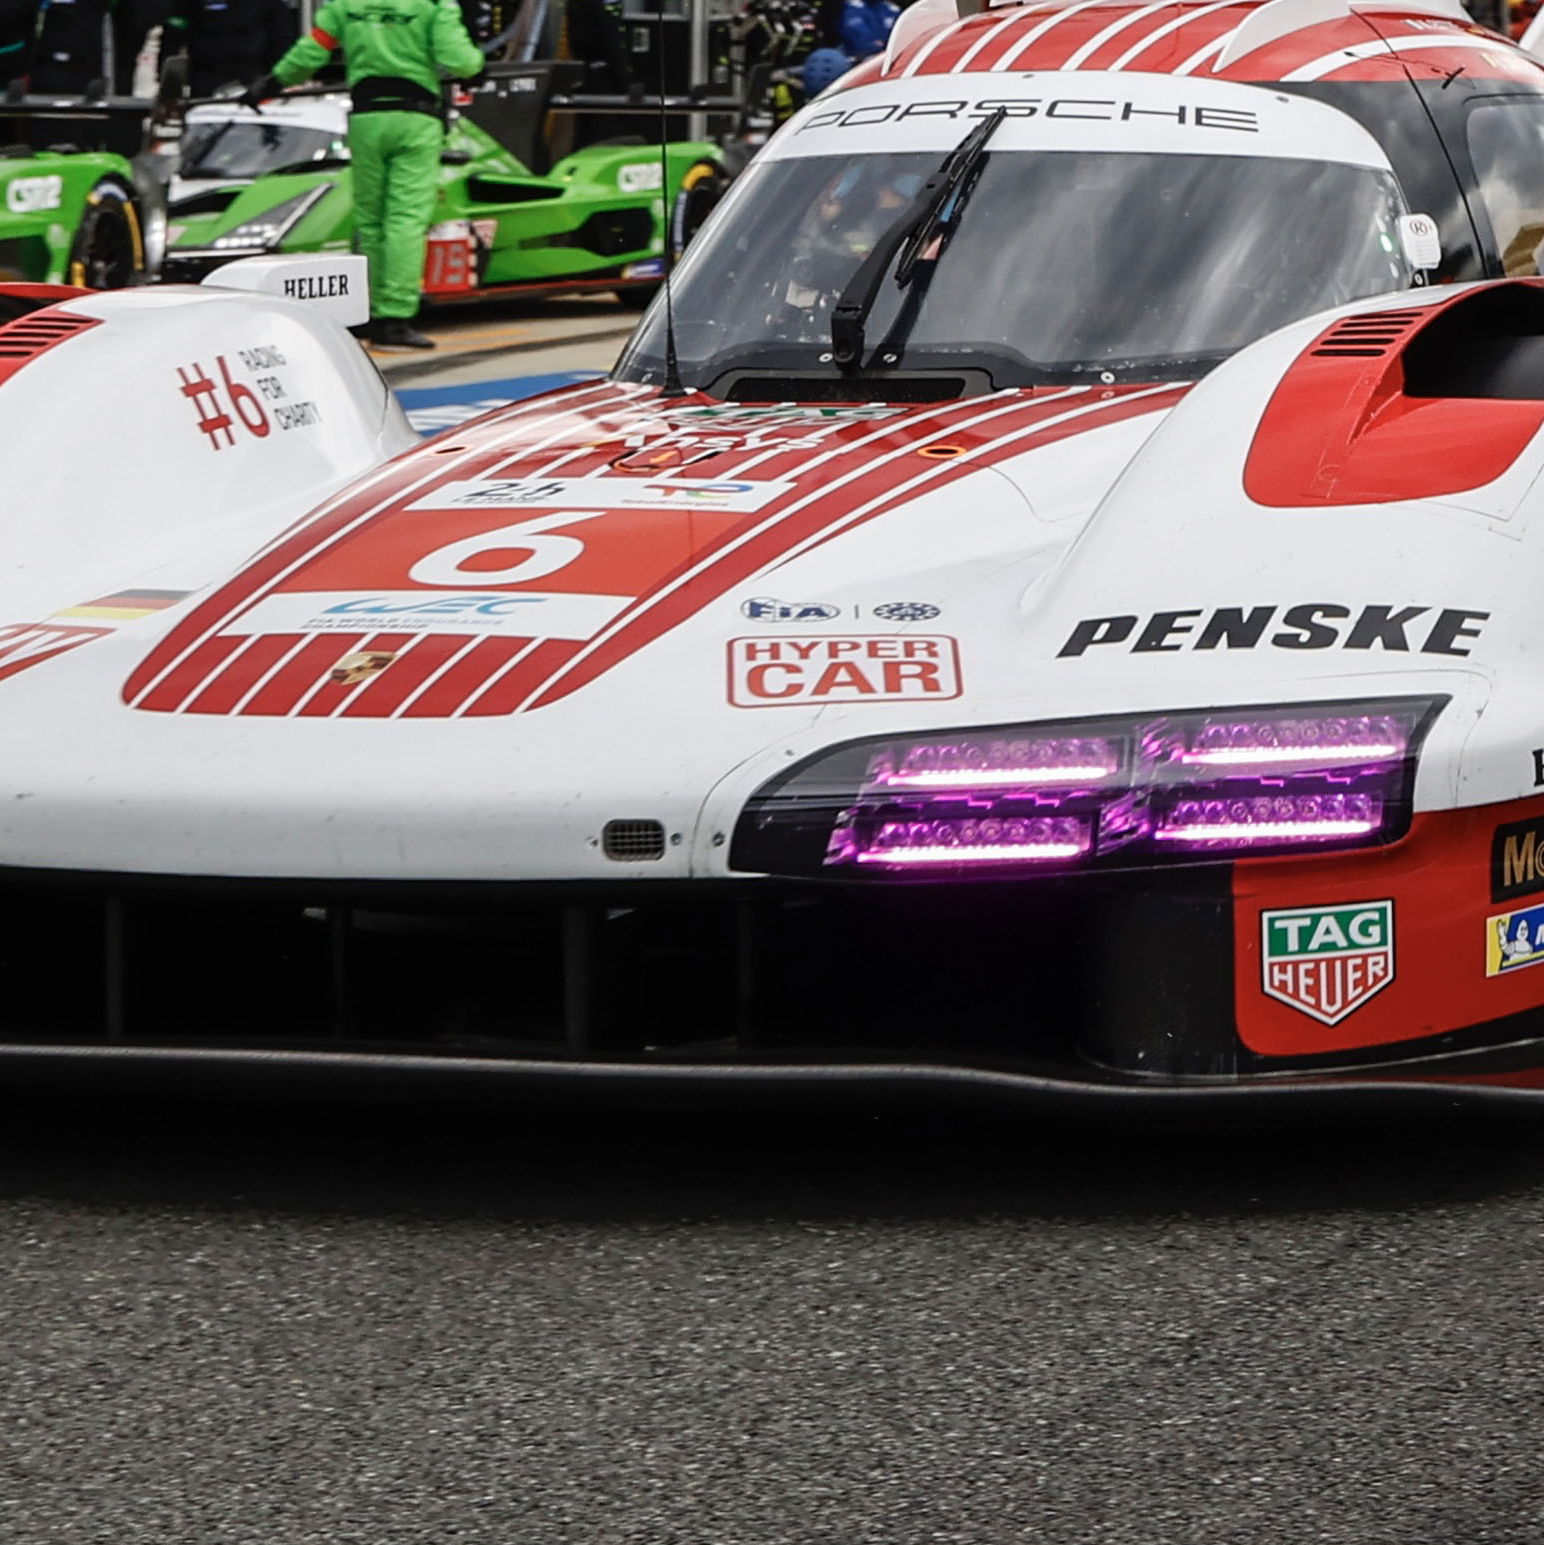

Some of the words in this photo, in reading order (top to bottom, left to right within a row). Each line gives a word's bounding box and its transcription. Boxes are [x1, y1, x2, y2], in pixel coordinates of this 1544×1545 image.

[795, 99, 1258, 136] PORSCHE
[284, 274, 349, 299] HELLER
[176, 356, 270, 450] #6
[256, 377, 286, 399] FOR
[408, 511, 608, 587] 6
[322, 595, 549, 616] WEC
[748, 601, 831, 619] FIA
[1055, 603, 1491, 659] PENSKE
[745, 640, 940, 662] HYPER
[746, 660, 942, 699] CAR
[1274, 911, 1381, 953] TAG
[1272, 955, 1386, 1014] HEUER
